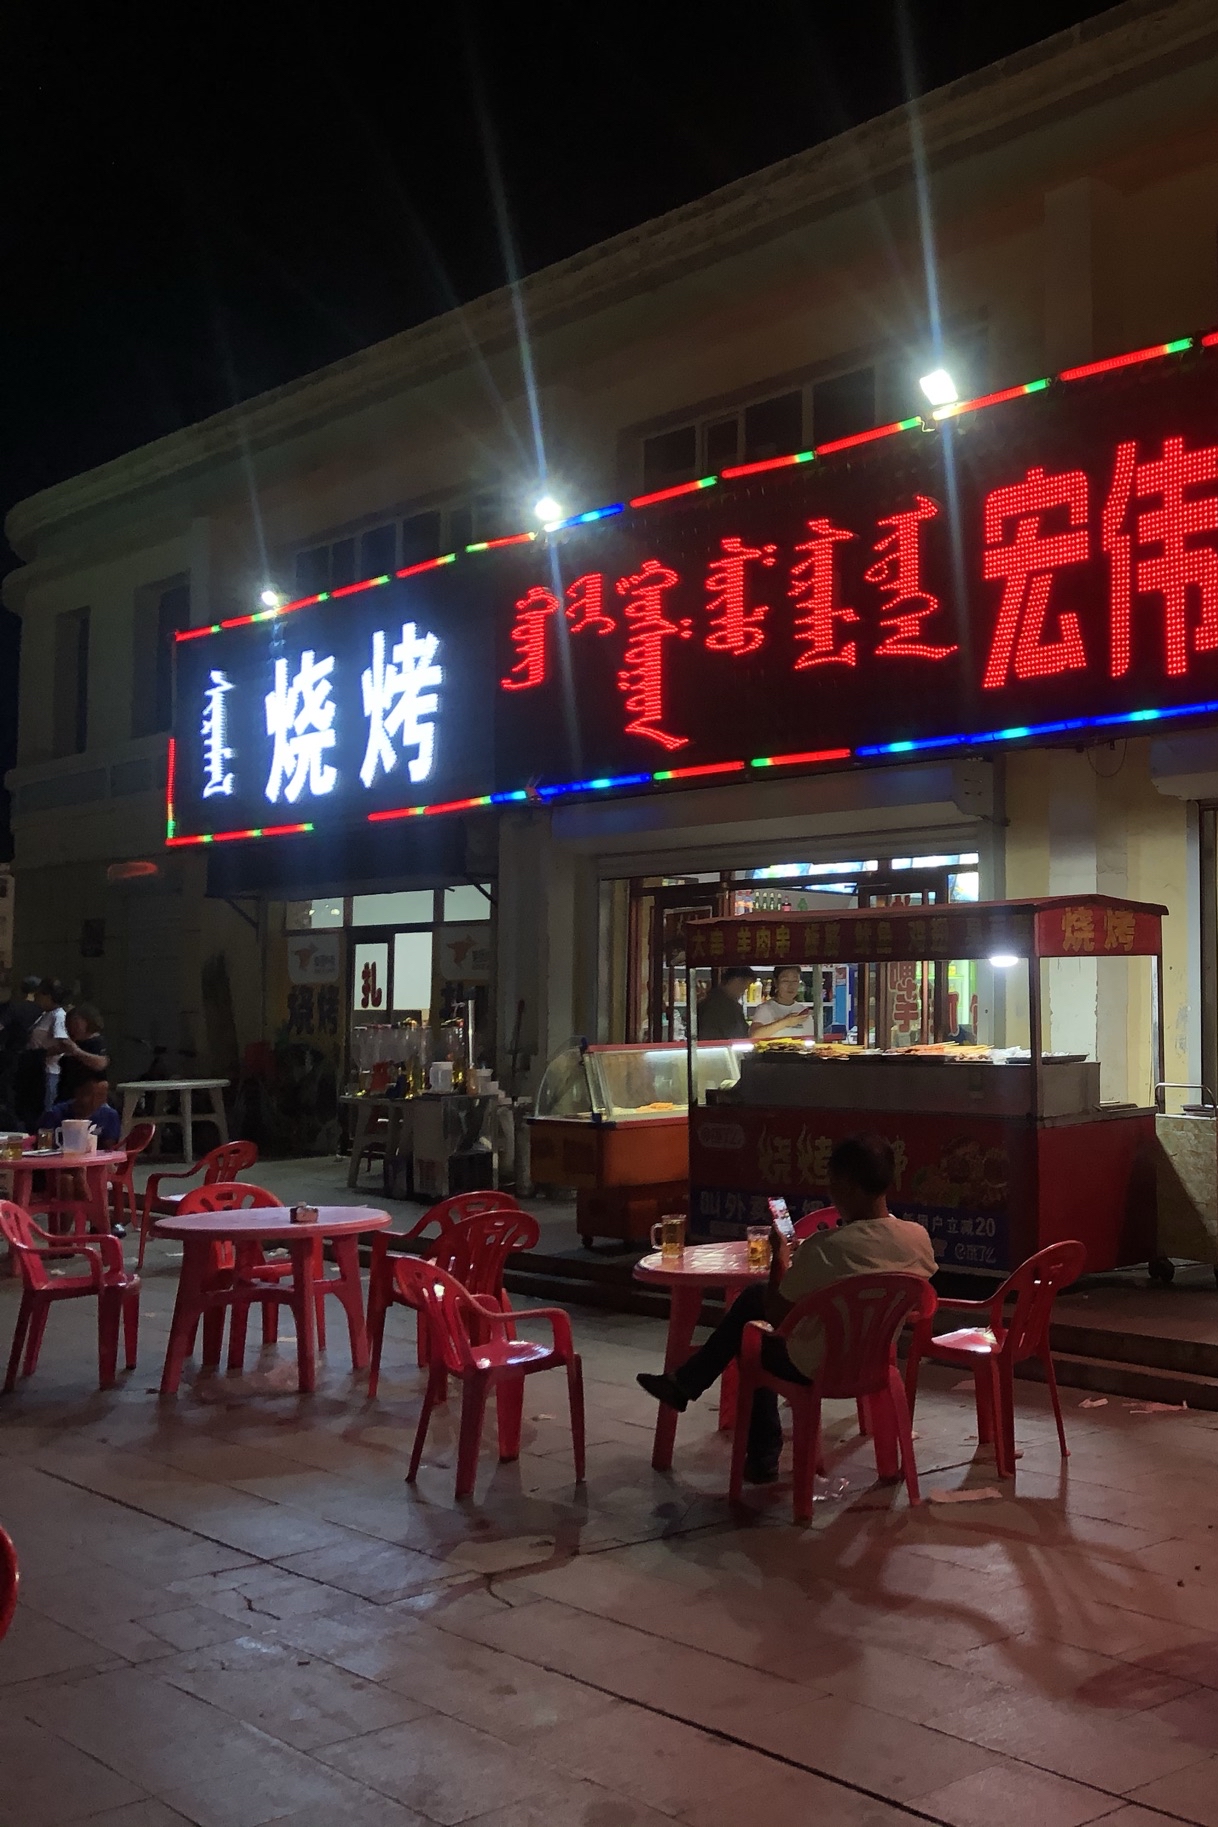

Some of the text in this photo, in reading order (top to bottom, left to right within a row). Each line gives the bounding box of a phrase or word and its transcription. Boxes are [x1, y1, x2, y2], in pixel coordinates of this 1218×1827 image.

[264, 621, 444, 804] 烧烤
[737, 925, 791, 960] 羊肉串
[1061, 905, 1137, 952] 烧烤
